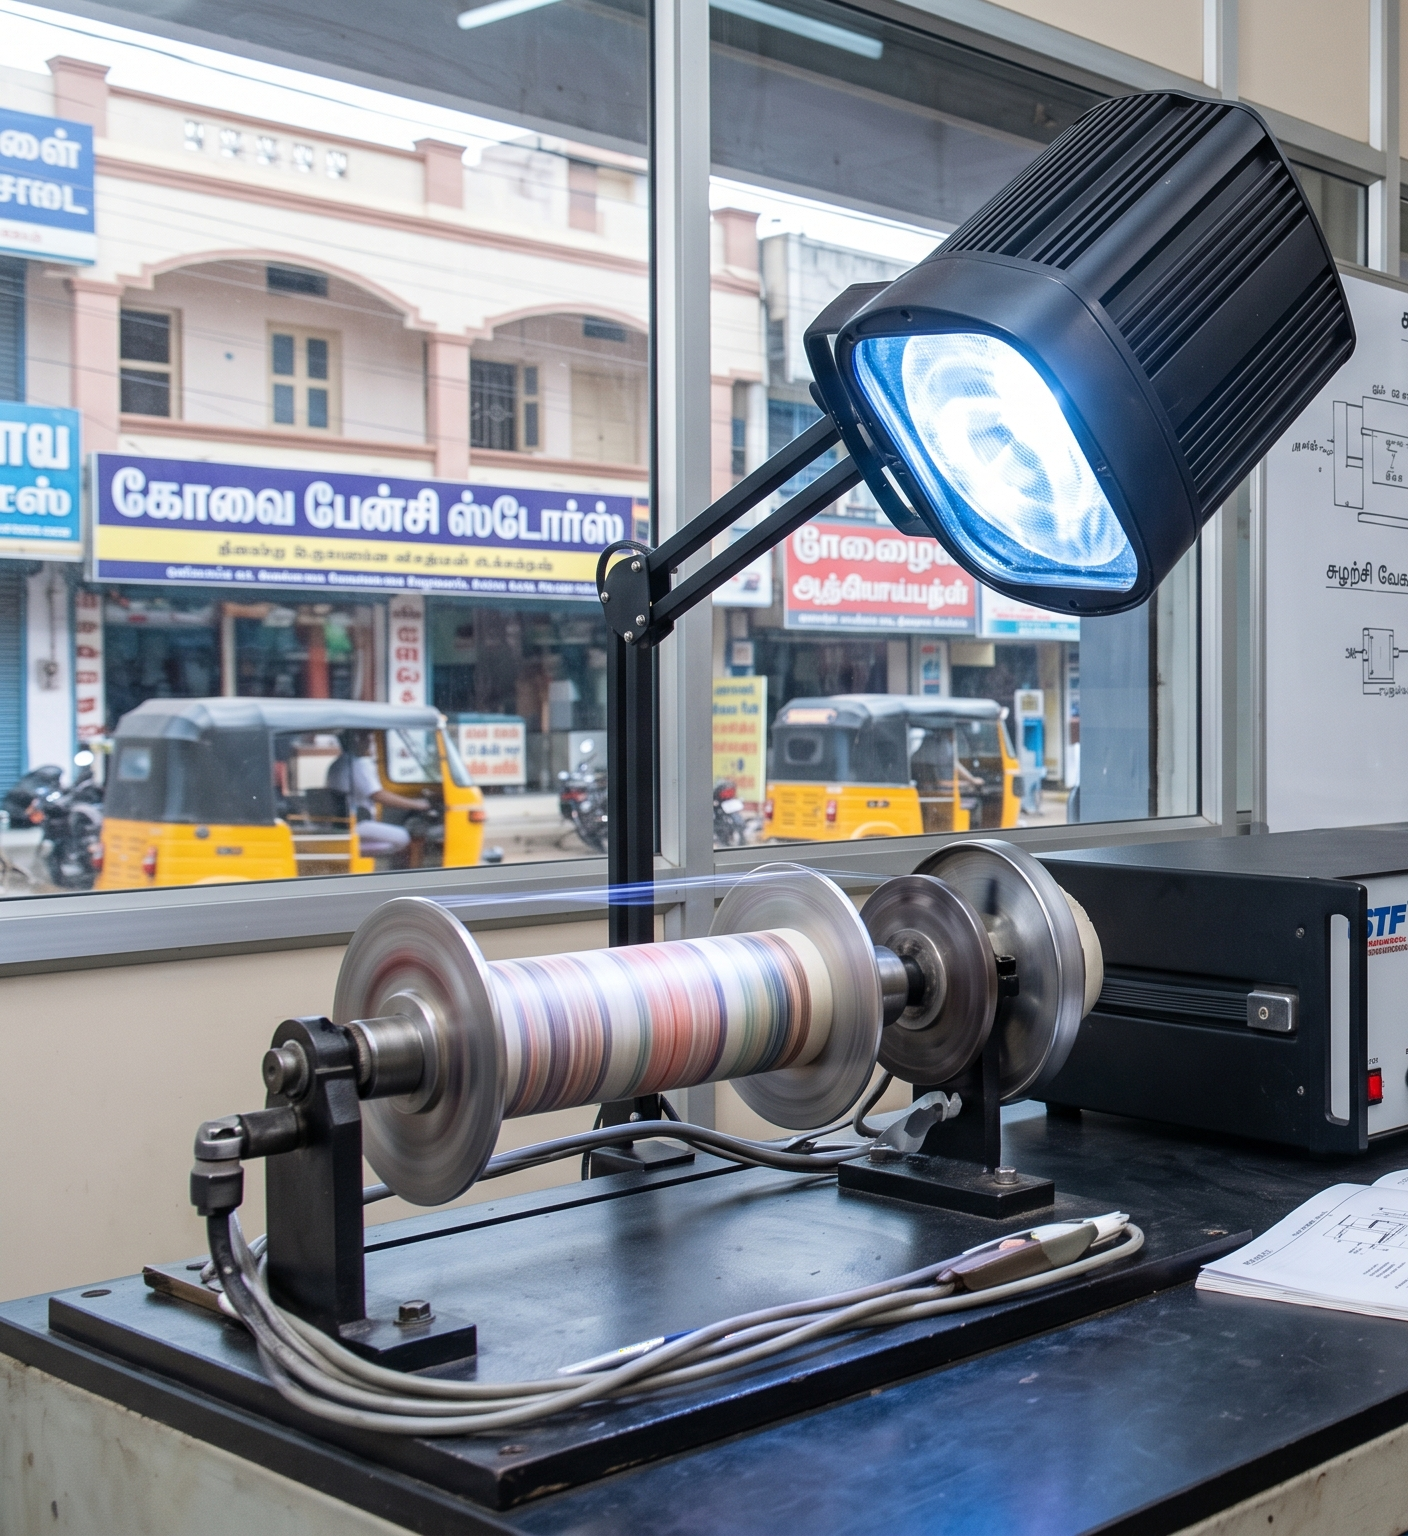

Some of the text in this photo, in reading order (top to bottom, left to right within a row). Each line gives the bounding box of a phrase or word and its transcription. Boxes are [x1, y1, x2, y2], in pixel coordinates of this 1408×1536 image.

[111, 466, 625, 545] கோவை பேன்சி ஸ்டோர்ஸ்
